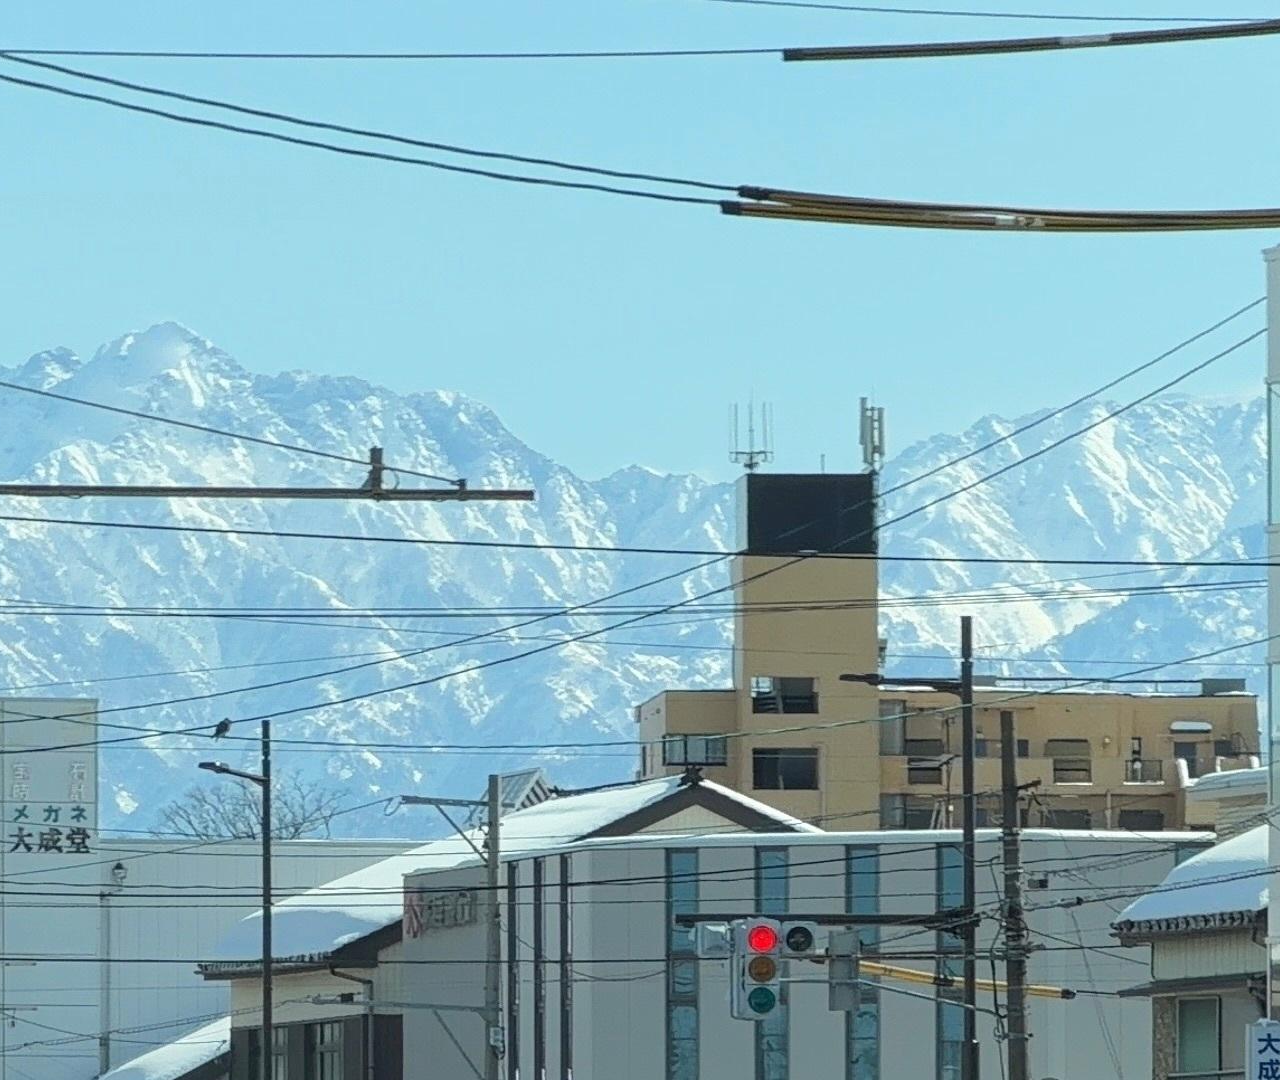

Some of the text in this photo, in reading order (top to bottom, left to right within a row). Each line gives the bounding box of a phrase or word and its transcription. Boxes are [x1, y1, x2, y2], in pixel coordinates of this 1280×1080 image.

[13, 805, 87, 823] メガネ
[9, 827, 90, 853] 大成堂
